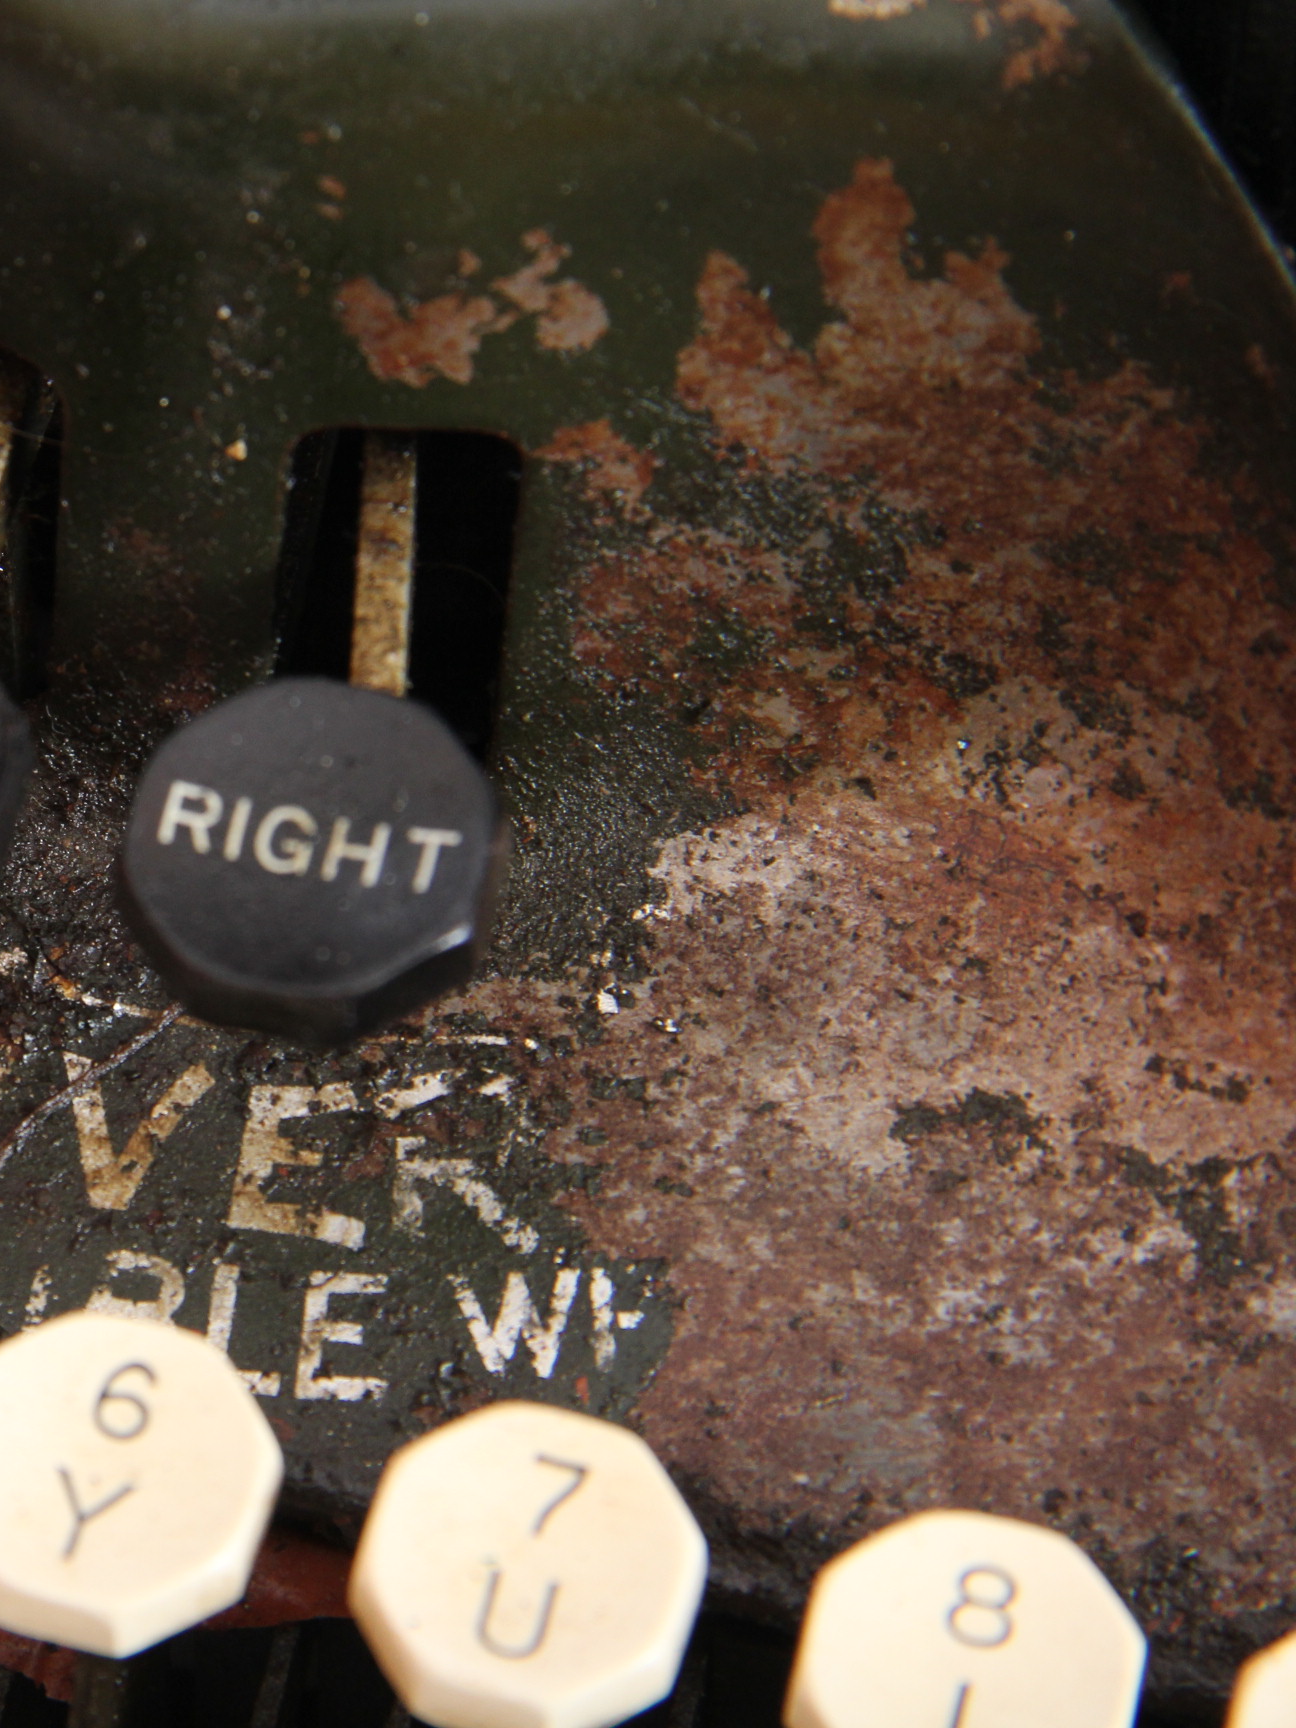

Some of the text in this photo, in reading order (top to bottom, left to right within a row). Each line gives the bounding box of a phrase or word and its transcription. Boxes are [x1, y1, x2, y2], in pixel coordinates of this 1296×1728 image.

[155, 780, 464, 896] RIGHT
[92, 1360, 160, 1441] 6
[57, 1466, 138, 1561] Y
[534, 1453, 589, 1537] 7
[474, 1568, 559, 1661] U
[942, 1564, 1017, 1650] 8
